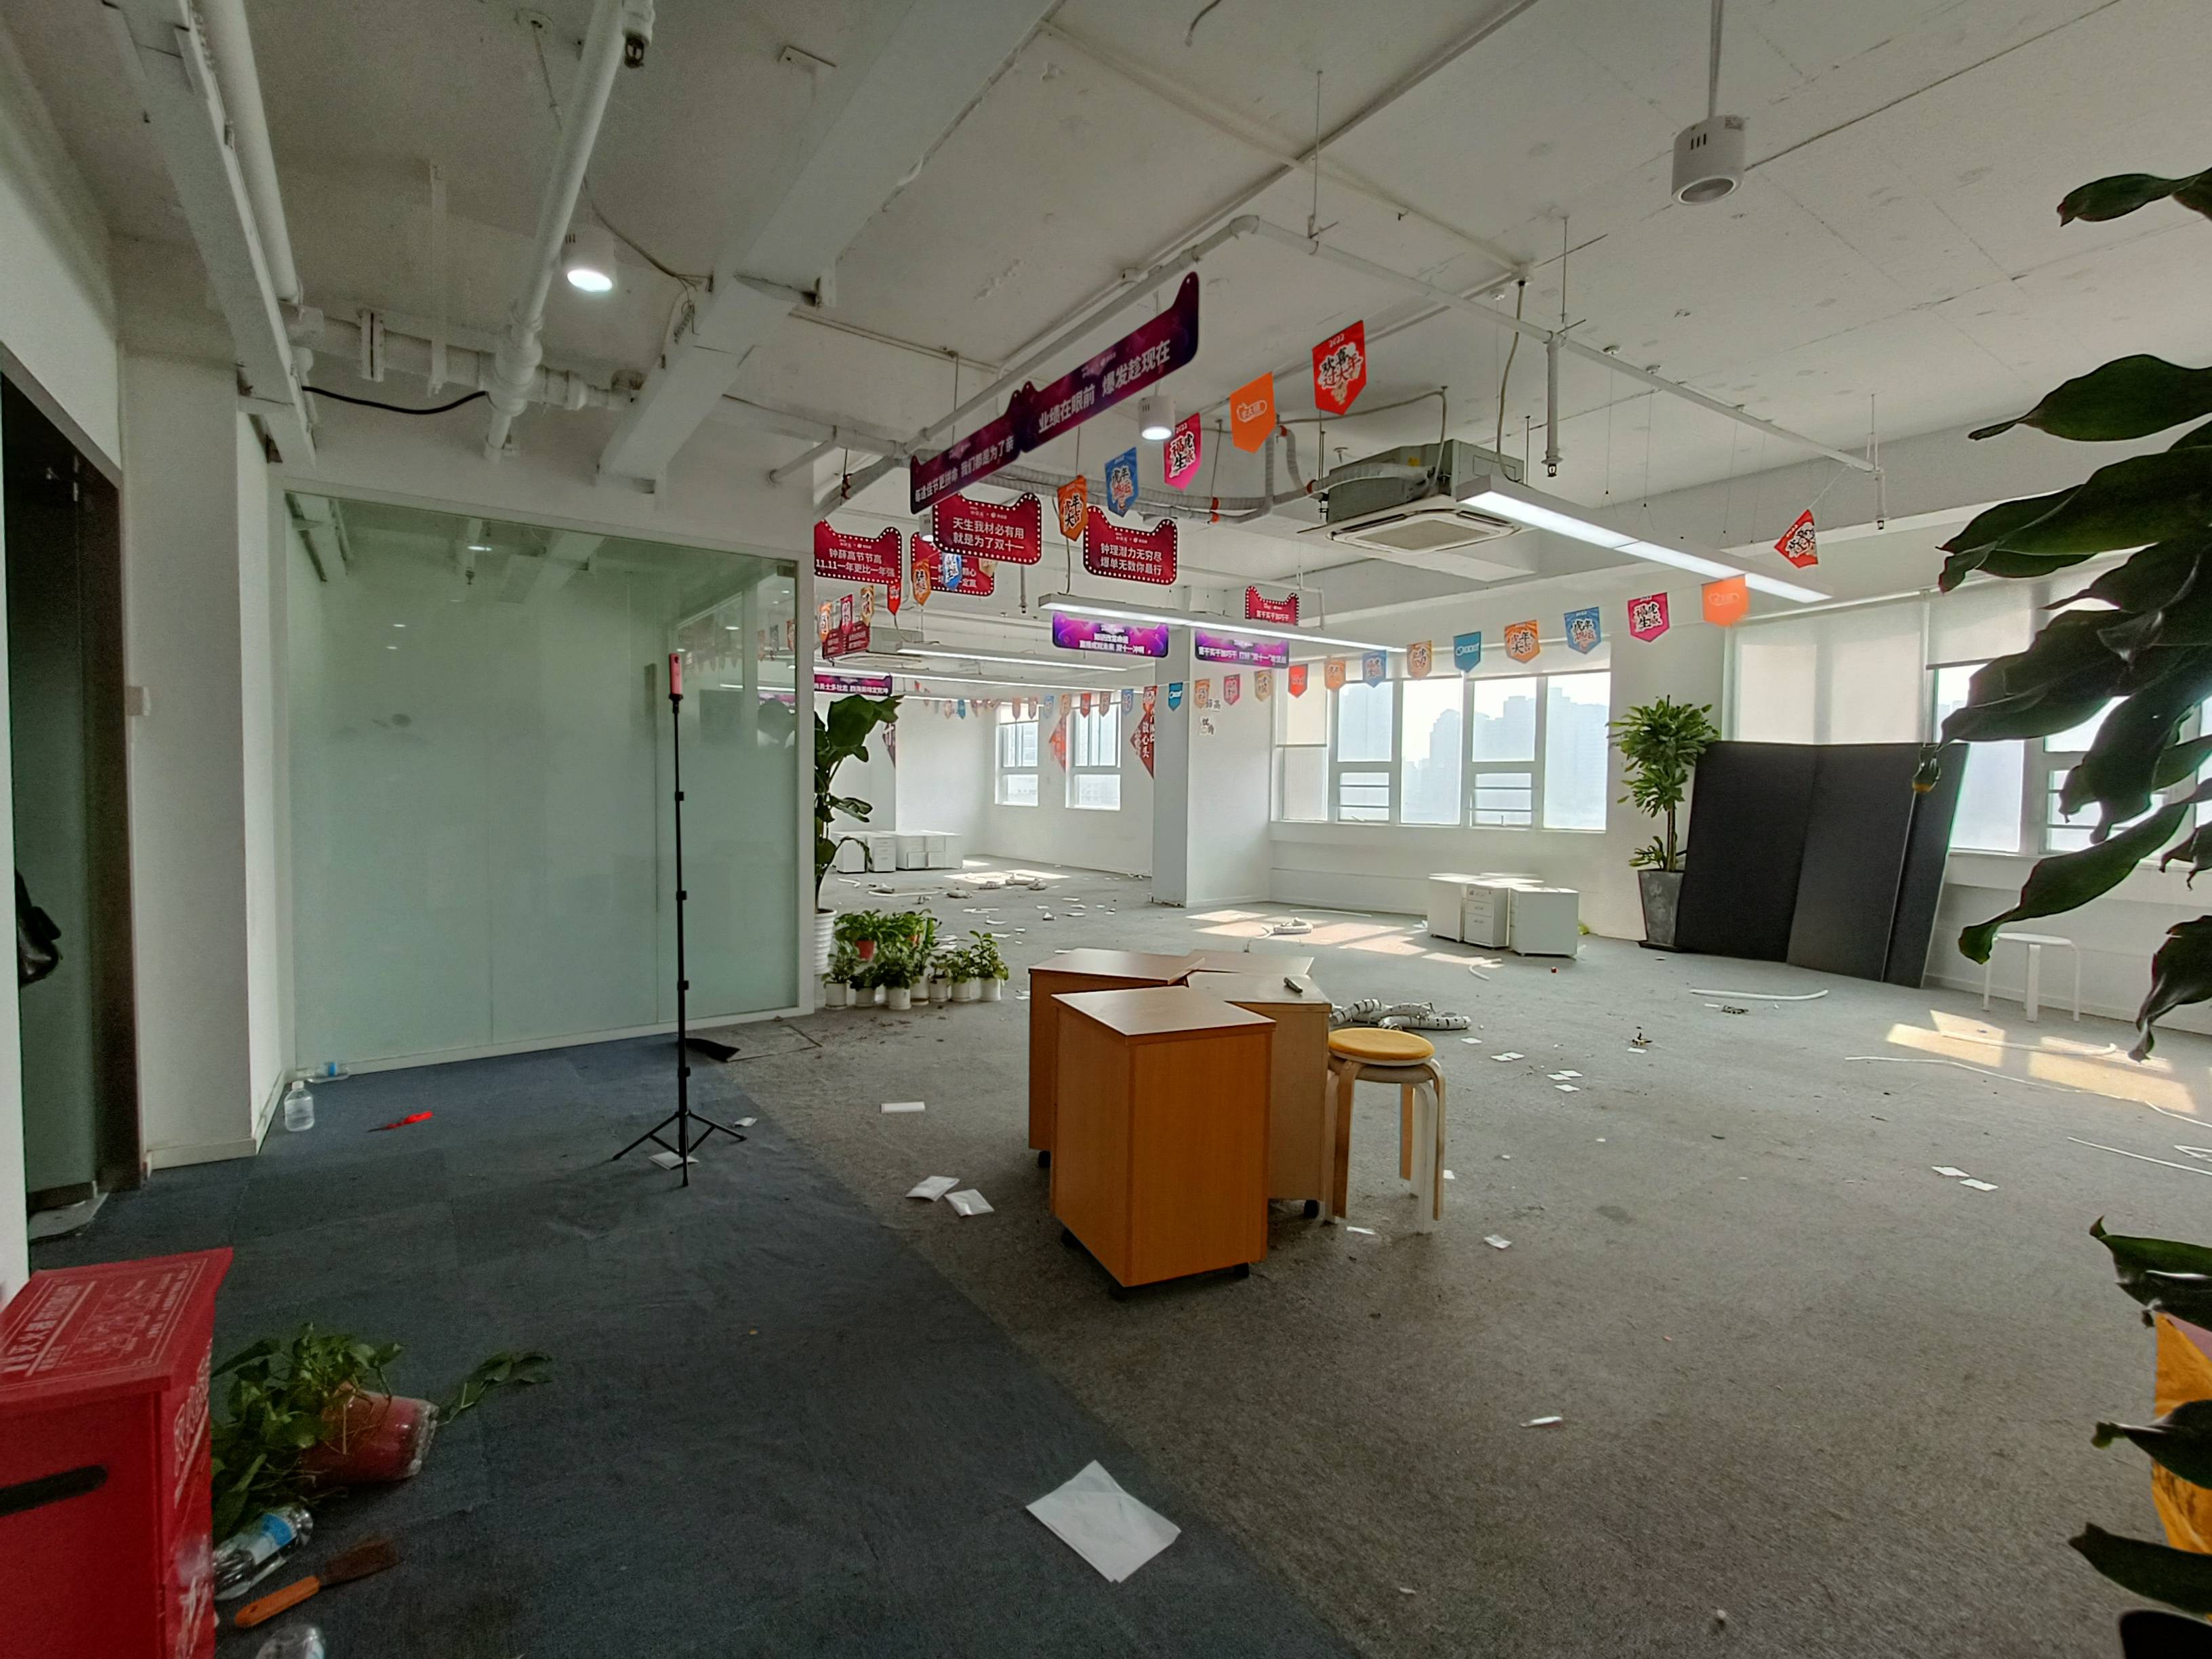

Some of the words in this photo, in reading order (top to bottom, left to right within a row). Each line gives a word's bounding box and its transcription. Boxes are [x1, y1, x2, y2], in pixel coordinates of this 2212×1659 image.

[1038, 383, 1096, 434] 业绩在眼前
[1102, 339, 1171, 398] 爆发趁现在
[915, 467, 958, 503] 每逢佳节更拼命
[960, 434, 1015, 478] 我们都是为了亲
[952, 516, 1025, 539] 天生我材必有用
[952, 531, 1025, 552] 就是为了双十一
[829, 548, 882, 565] 钟薛高节节高
[1100, 542, 1162, 562] 钟理潜力无穷尽
[815, 558, 895, 577] 11.11一年更比一年强
[1100, 556, 1162, 576] 爆单无数你最行
